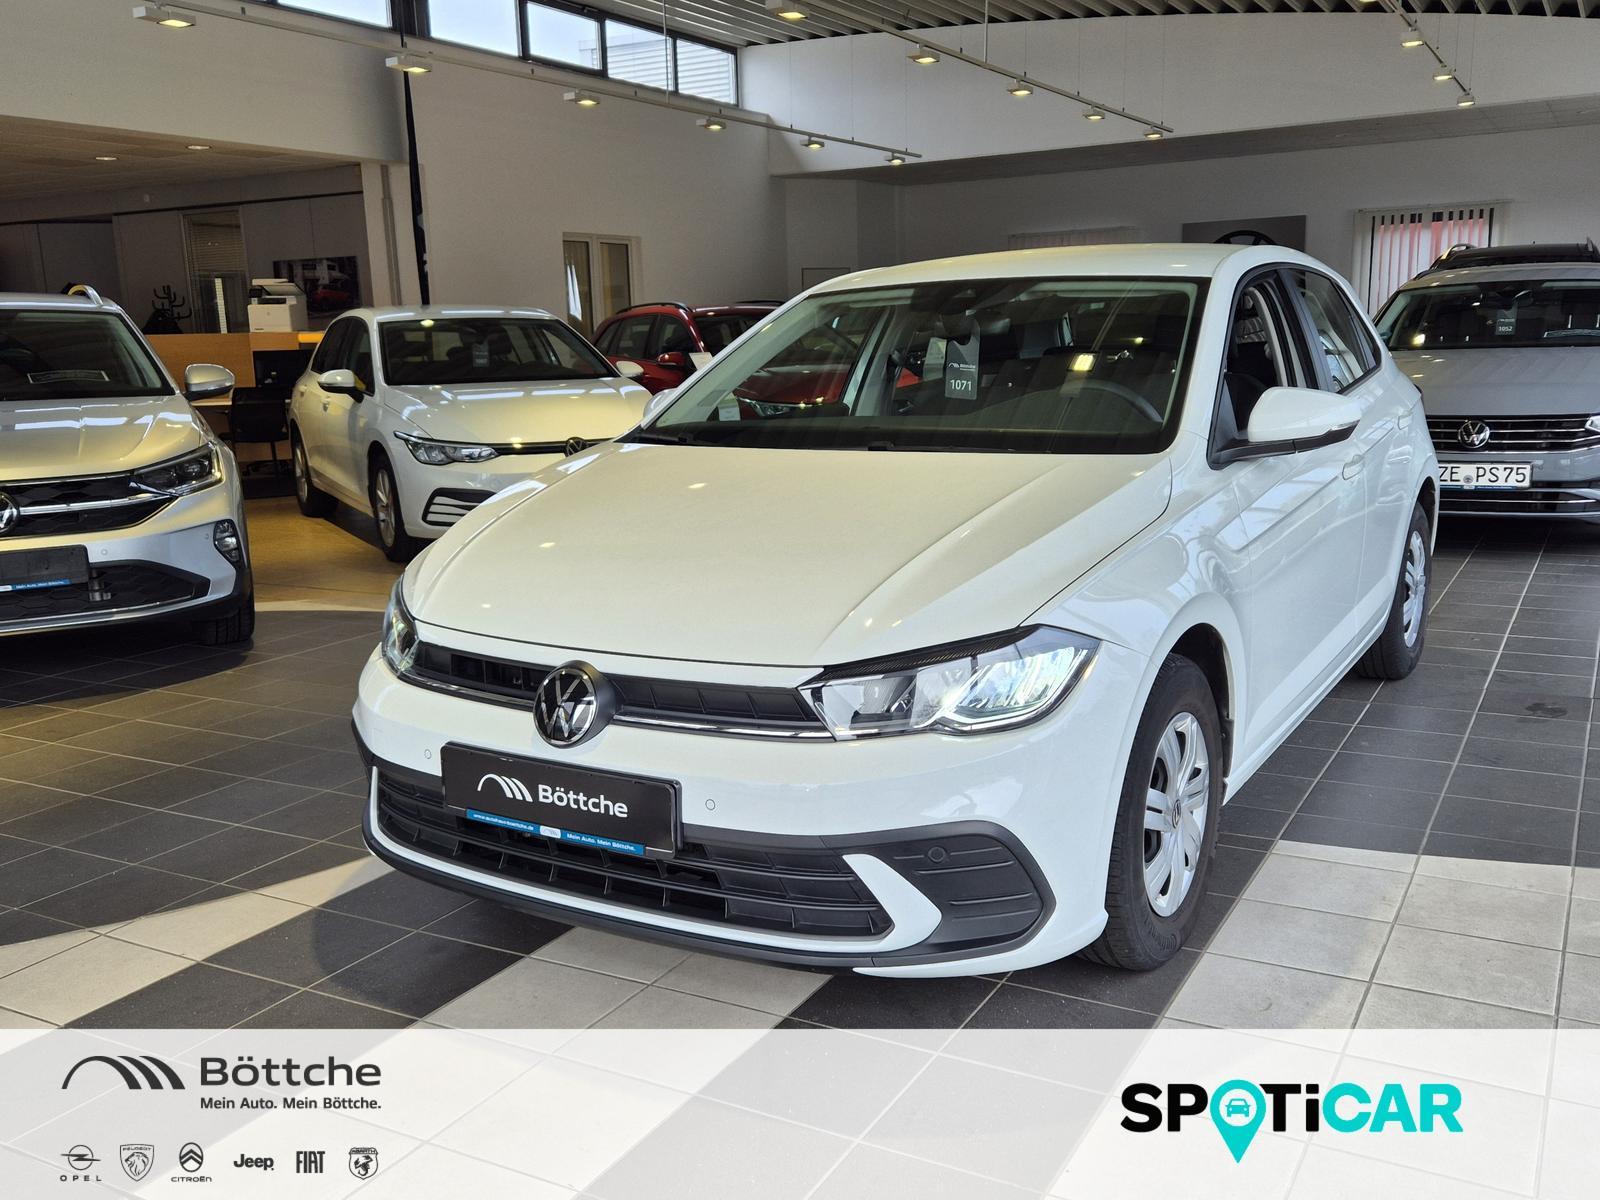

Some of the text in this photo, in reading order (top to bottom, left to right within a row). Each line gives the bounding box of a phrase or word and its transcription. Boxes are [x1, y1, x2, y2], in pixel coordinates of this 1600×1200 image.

[950, 379, 972, 391] 1071
[538, 783, 628, 818] Böttche
[566, 833, 580, 841] Mein
